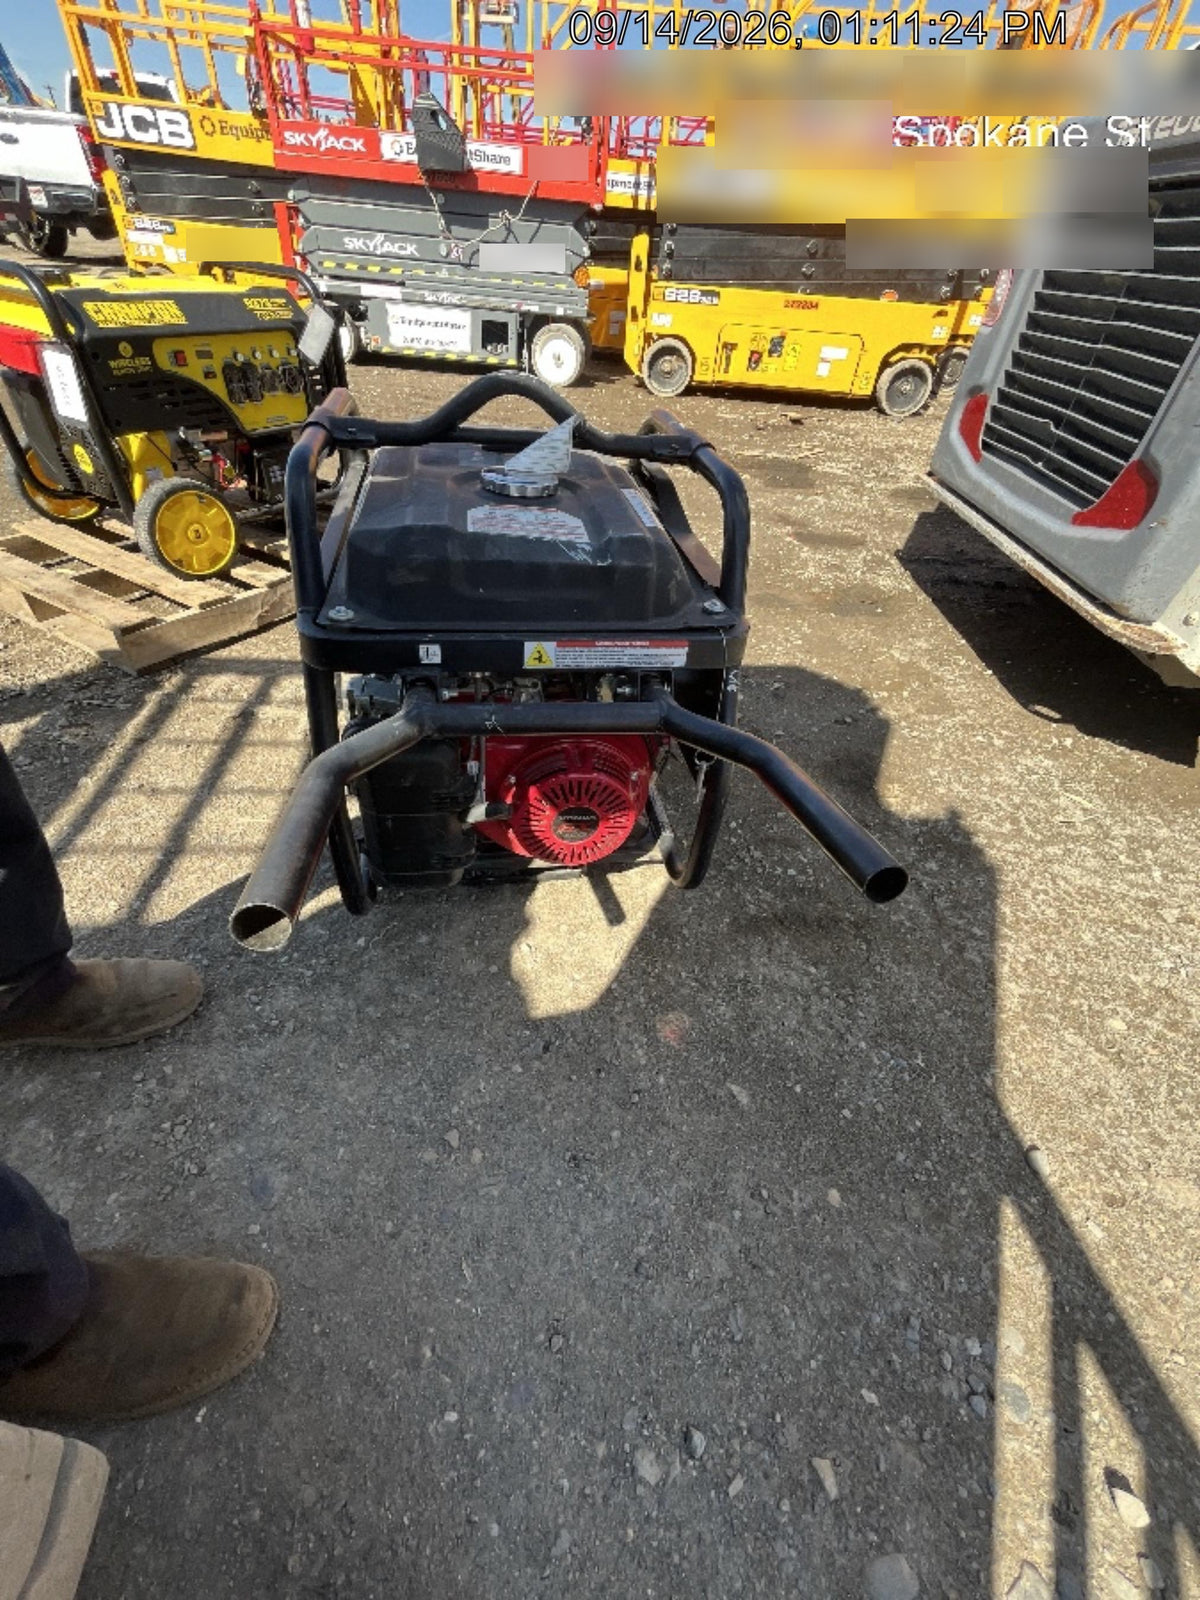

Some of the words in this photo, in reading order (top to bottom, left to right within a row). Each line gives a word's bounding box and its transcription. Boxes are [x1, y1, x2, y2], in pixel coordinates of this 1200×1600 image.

[95, 102, 195, 148] JCB
[283, 127, 367, 152] SKYJACK
[343, 233, 420, 257] SKYJACK
